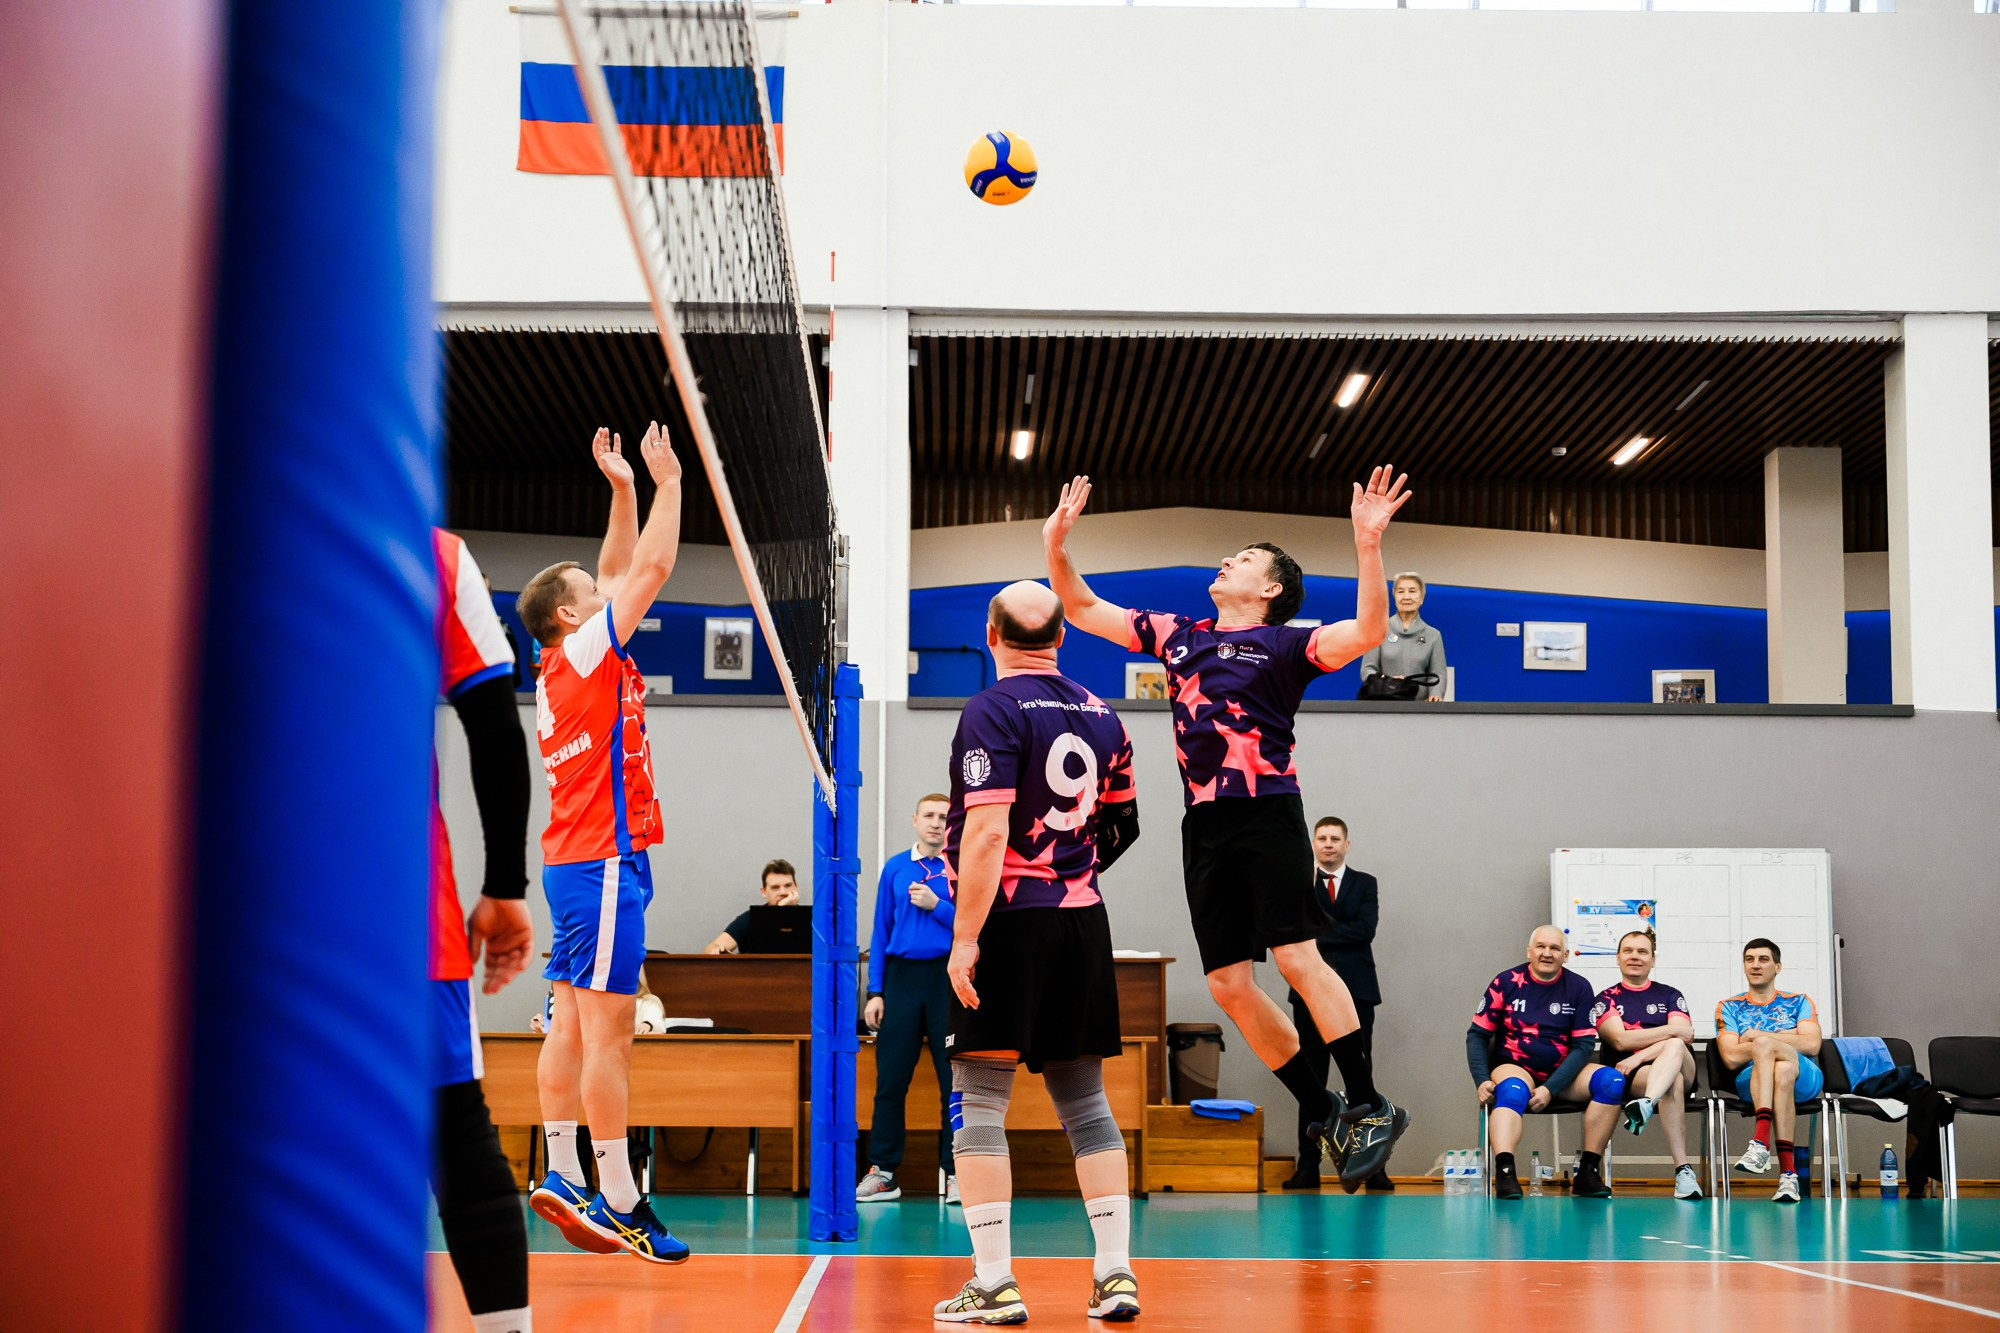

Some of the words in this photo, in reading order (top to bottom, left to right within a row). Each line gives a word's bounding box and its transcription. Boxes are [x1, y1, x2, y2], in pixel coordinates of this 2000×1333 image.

[1170, 645, 1188, 664] 2
[1043, 732, 1098, 831] 9
[1511, 998, 1527, 1013] 11
[1089, 1211, 1115, 1220] EMIX
[970, 1219, 1004, 1230] DEMIX
